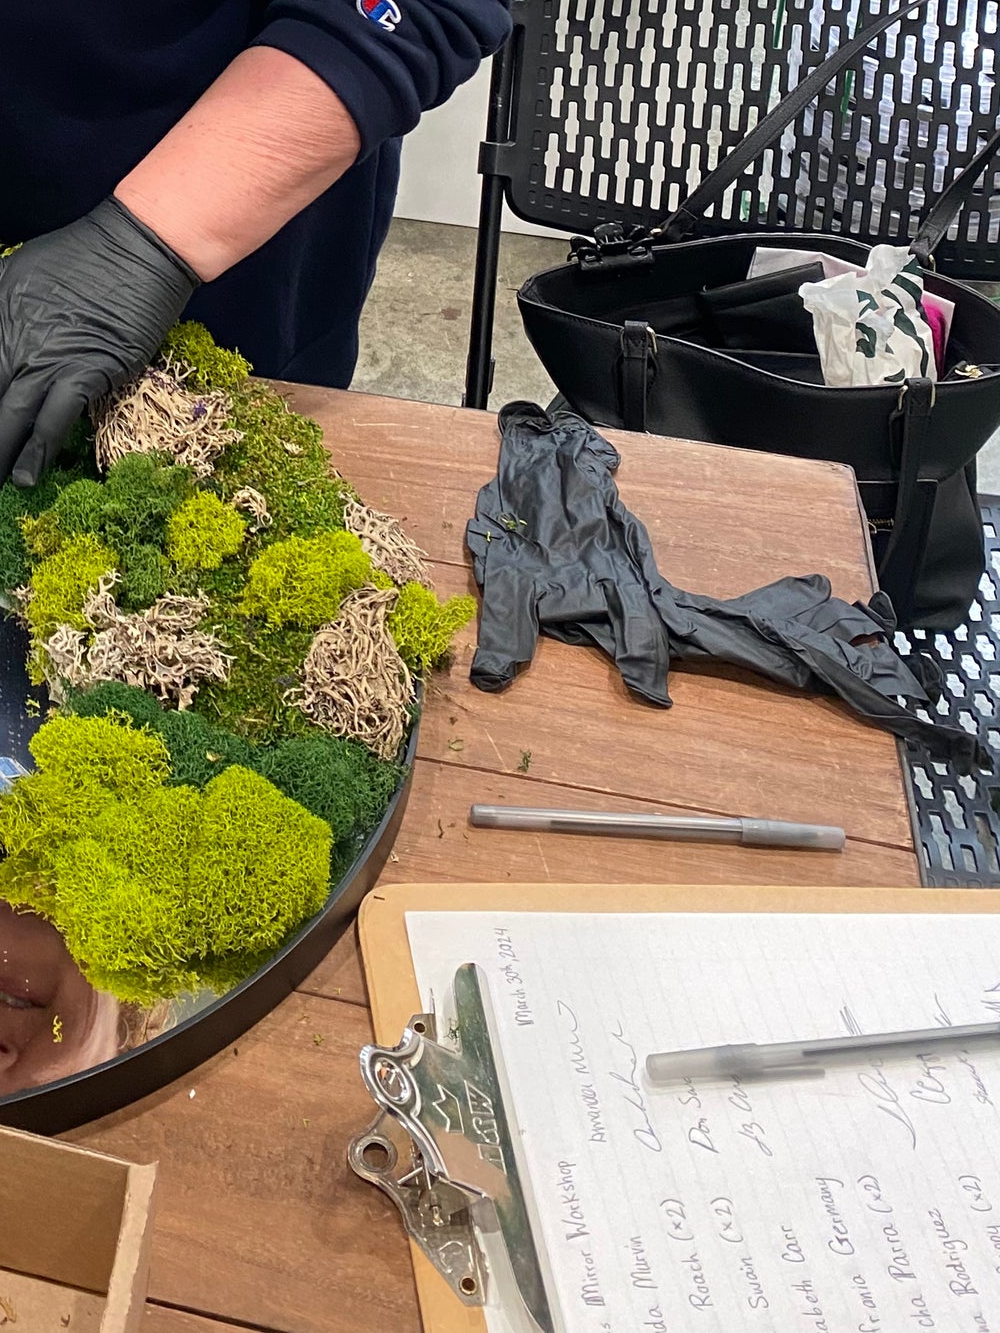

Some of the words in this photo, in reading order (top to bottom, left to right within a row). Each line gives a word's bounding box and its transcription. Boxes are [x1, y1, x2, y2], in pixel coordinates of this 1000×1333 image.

[514, 988, 534, 1026] March
[558, 1160, 590, 1241] Workshop
[815, 1177, 855, 1255] Germany
[624, 1235, 658, 1289] Murvin
[781, 1225, 806, 1263] Carr
[882, 1222, 917, 1283] Parra
[928, 1208, 979, 1297] Rodriguez
[580, 1249, 606, 1307] Mirror
[681, 1252, 714, 1311] Roach
[740, 1257, 769, 1309] Swain
